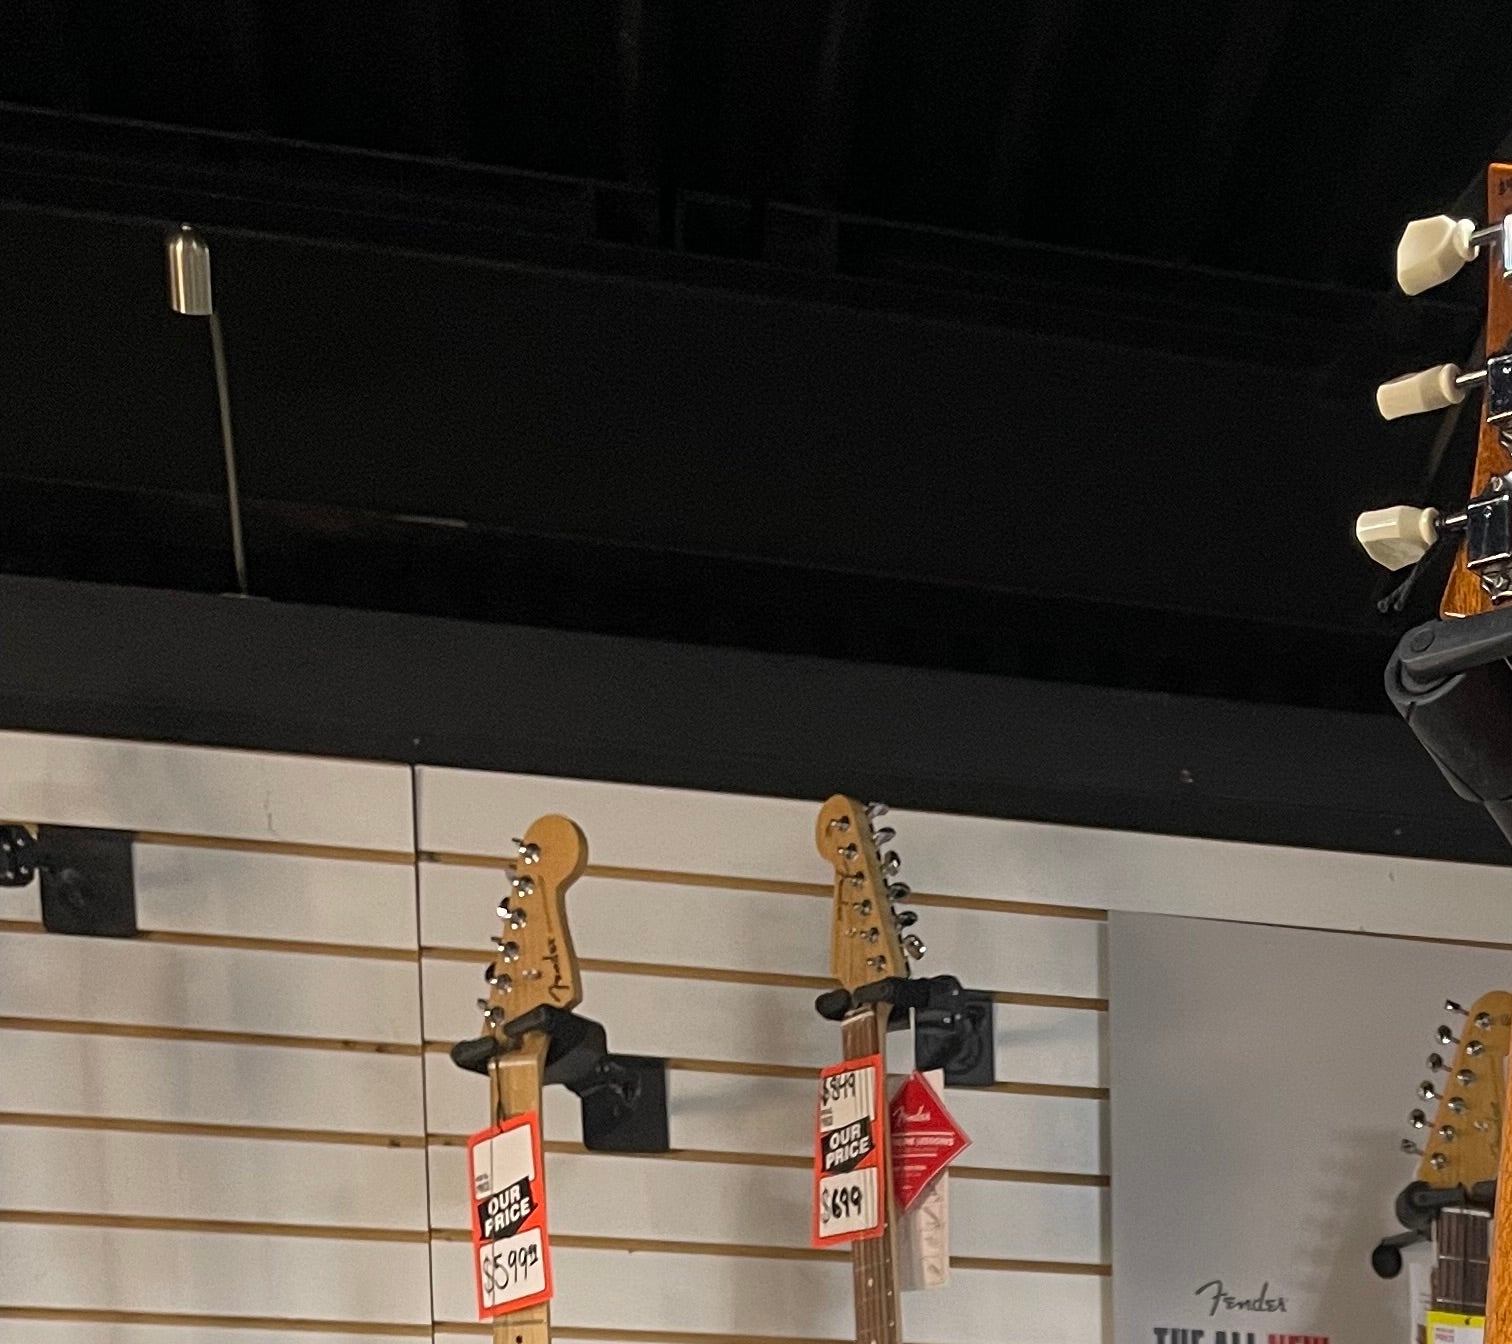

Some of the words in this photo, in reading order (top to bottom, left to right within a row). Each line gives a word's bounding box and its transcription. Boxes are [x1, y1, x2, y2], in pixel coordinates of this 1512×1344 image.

[825, 1136, 870, 1170] PRICE
[829, 1124, 861, 1149] OUR
[484, 1196, 531, 1238] PRICE
[487, 1184, 521, 1217] OUR
[1194, 1279, 1288, 1317] Fender
